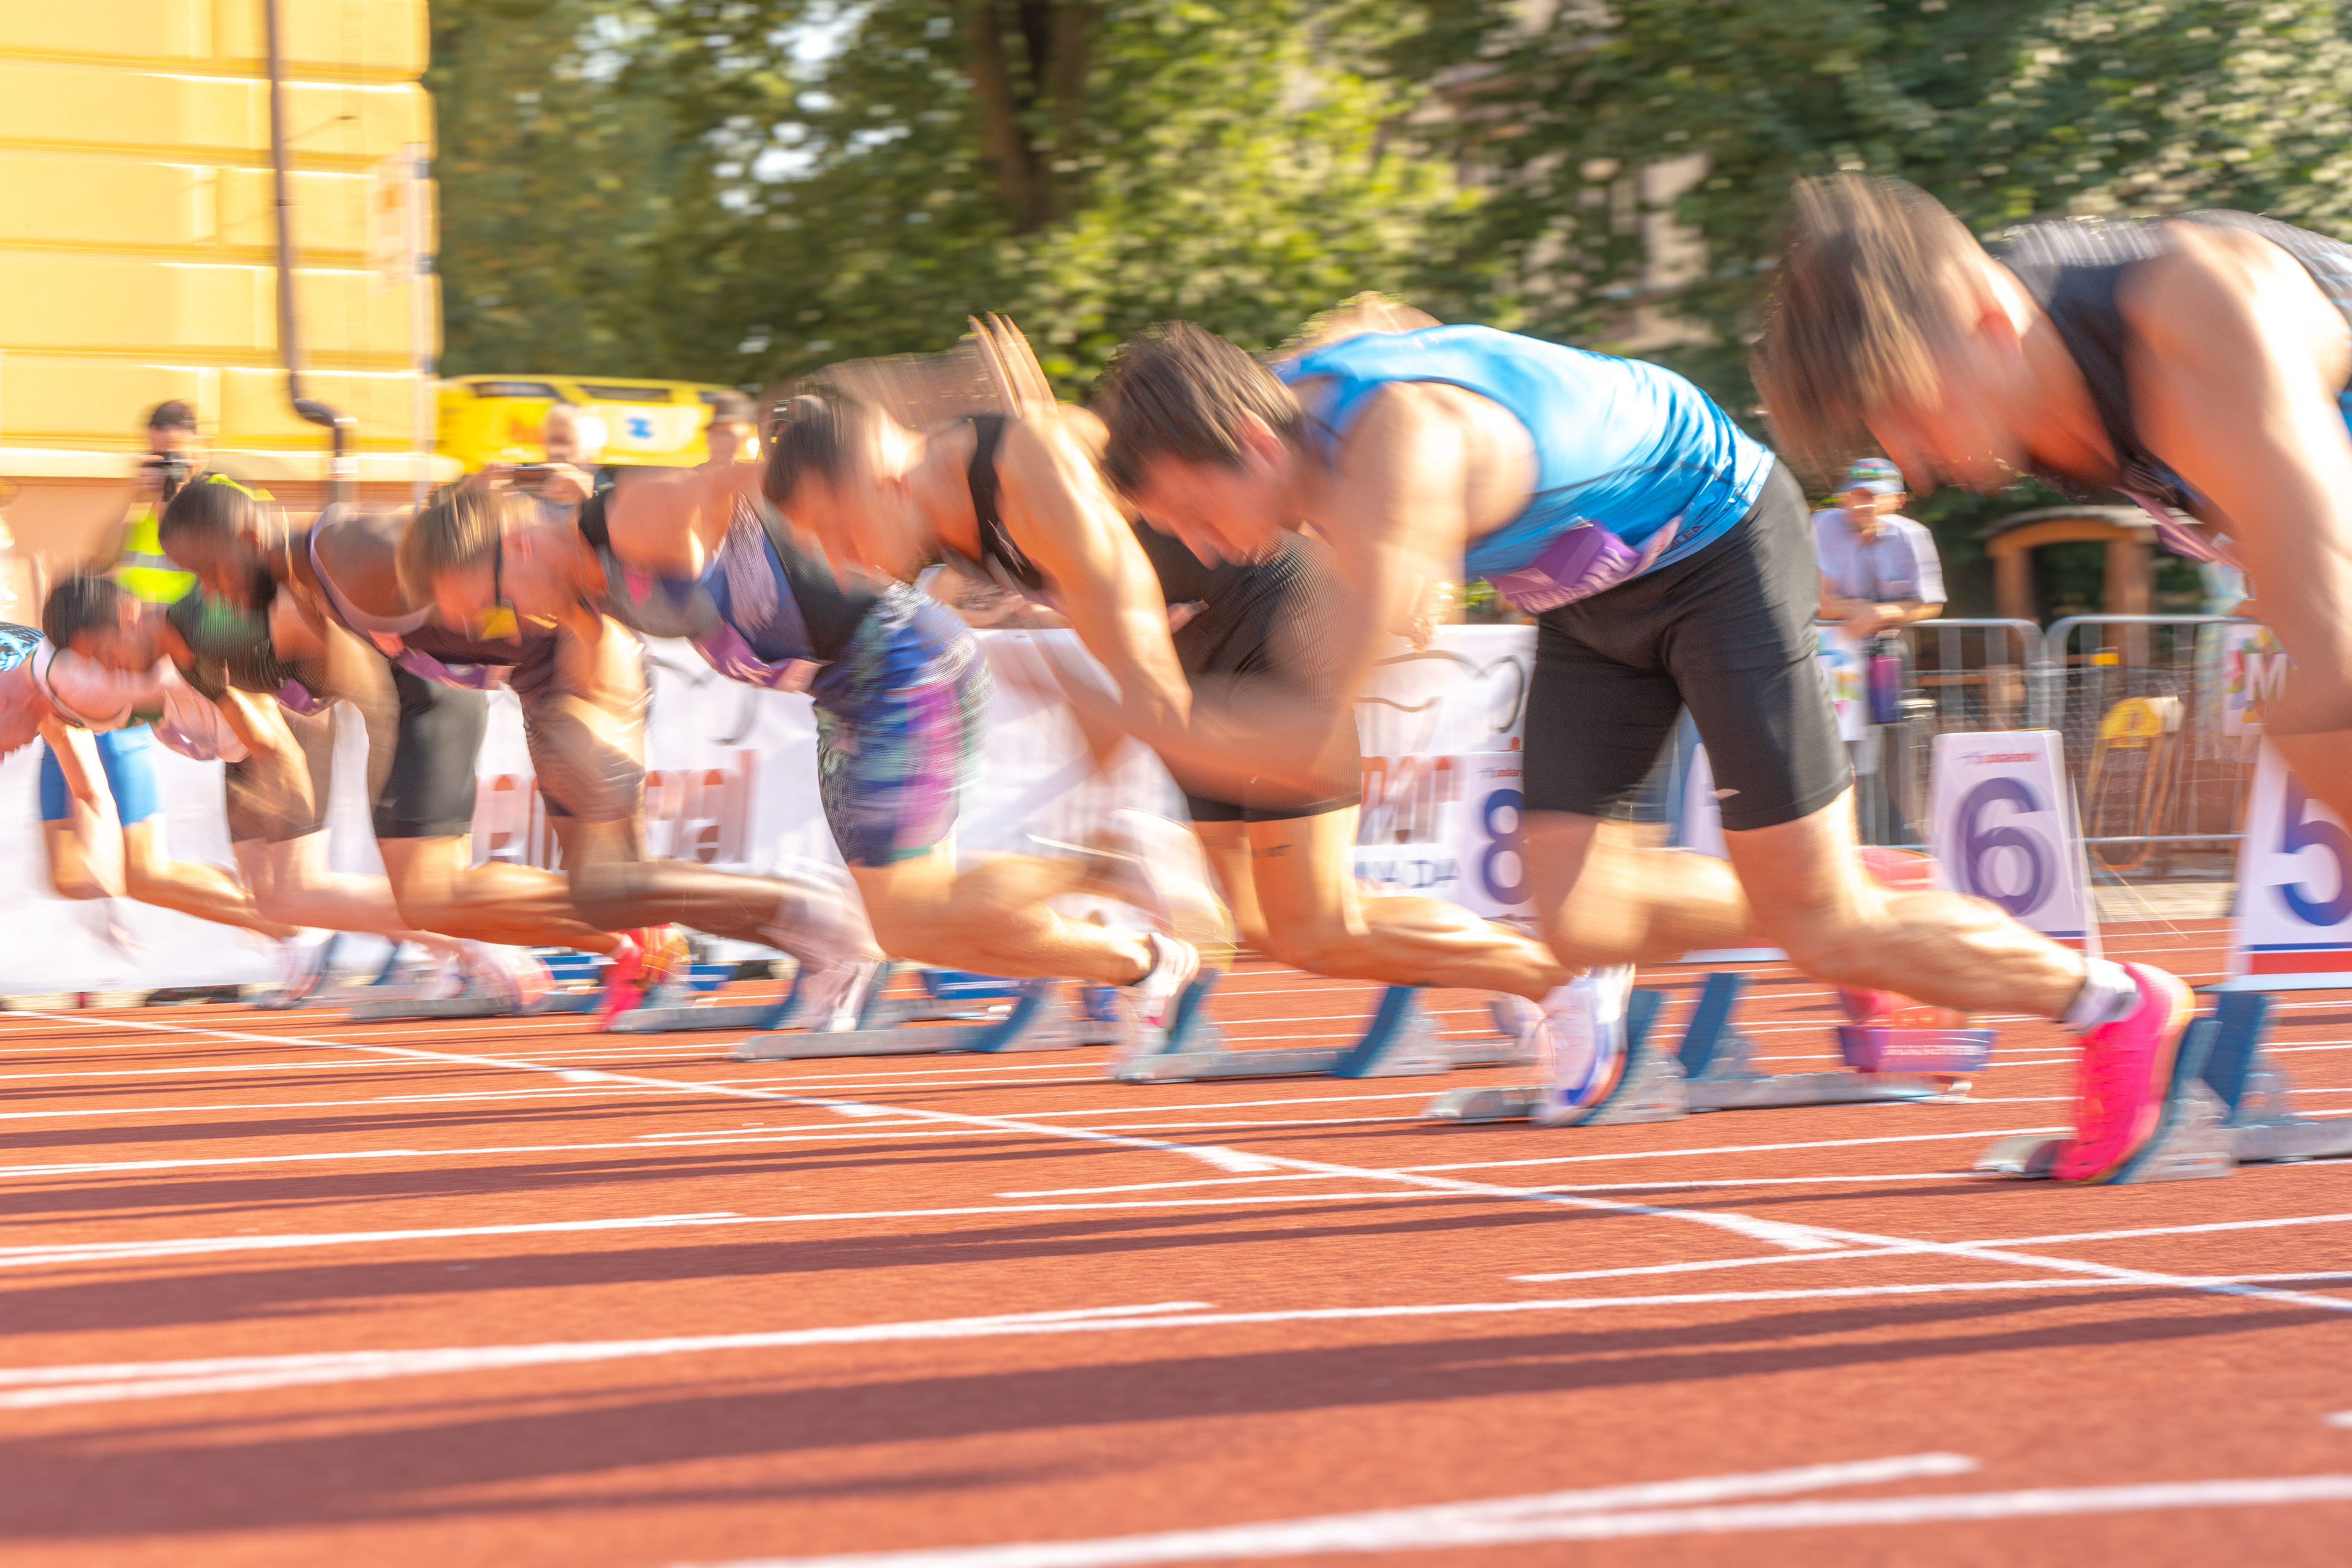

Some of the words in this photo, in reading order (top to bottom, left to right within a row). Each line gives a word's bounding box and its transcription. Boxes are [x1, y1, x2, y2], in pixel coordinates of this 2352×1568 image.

[1482, 788, 1536, 905] 8
[1956, 776, 2054, 918] 6
[2278, 770, 2352, 927] 5
